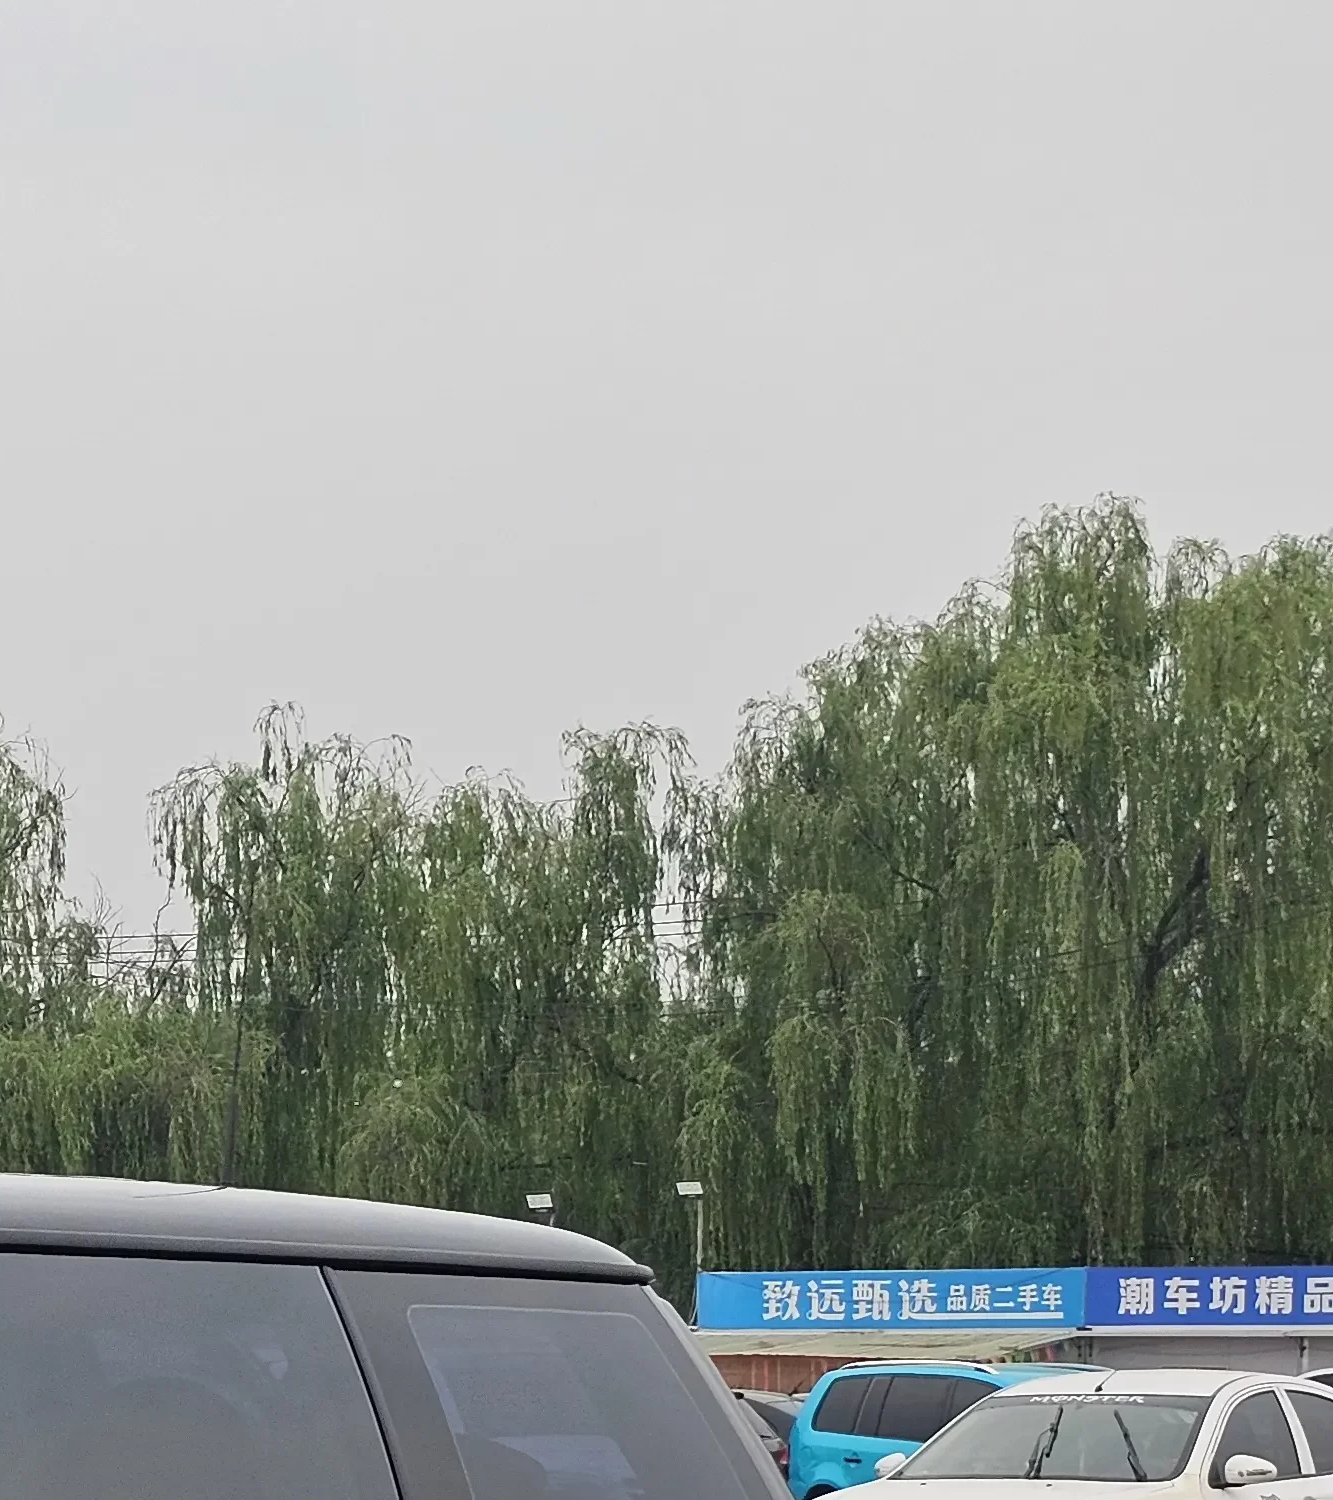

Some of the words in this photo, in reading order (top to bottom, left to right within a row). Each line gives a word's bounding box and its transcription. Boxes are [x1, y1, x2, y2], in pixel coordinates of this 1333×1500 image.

[761, 1279, 938, 1321] 致远甄选
[946, 1283, 1063, 1312] 品质二手车
[1117, 1276, 1333, 1315] 潮车坊精品
